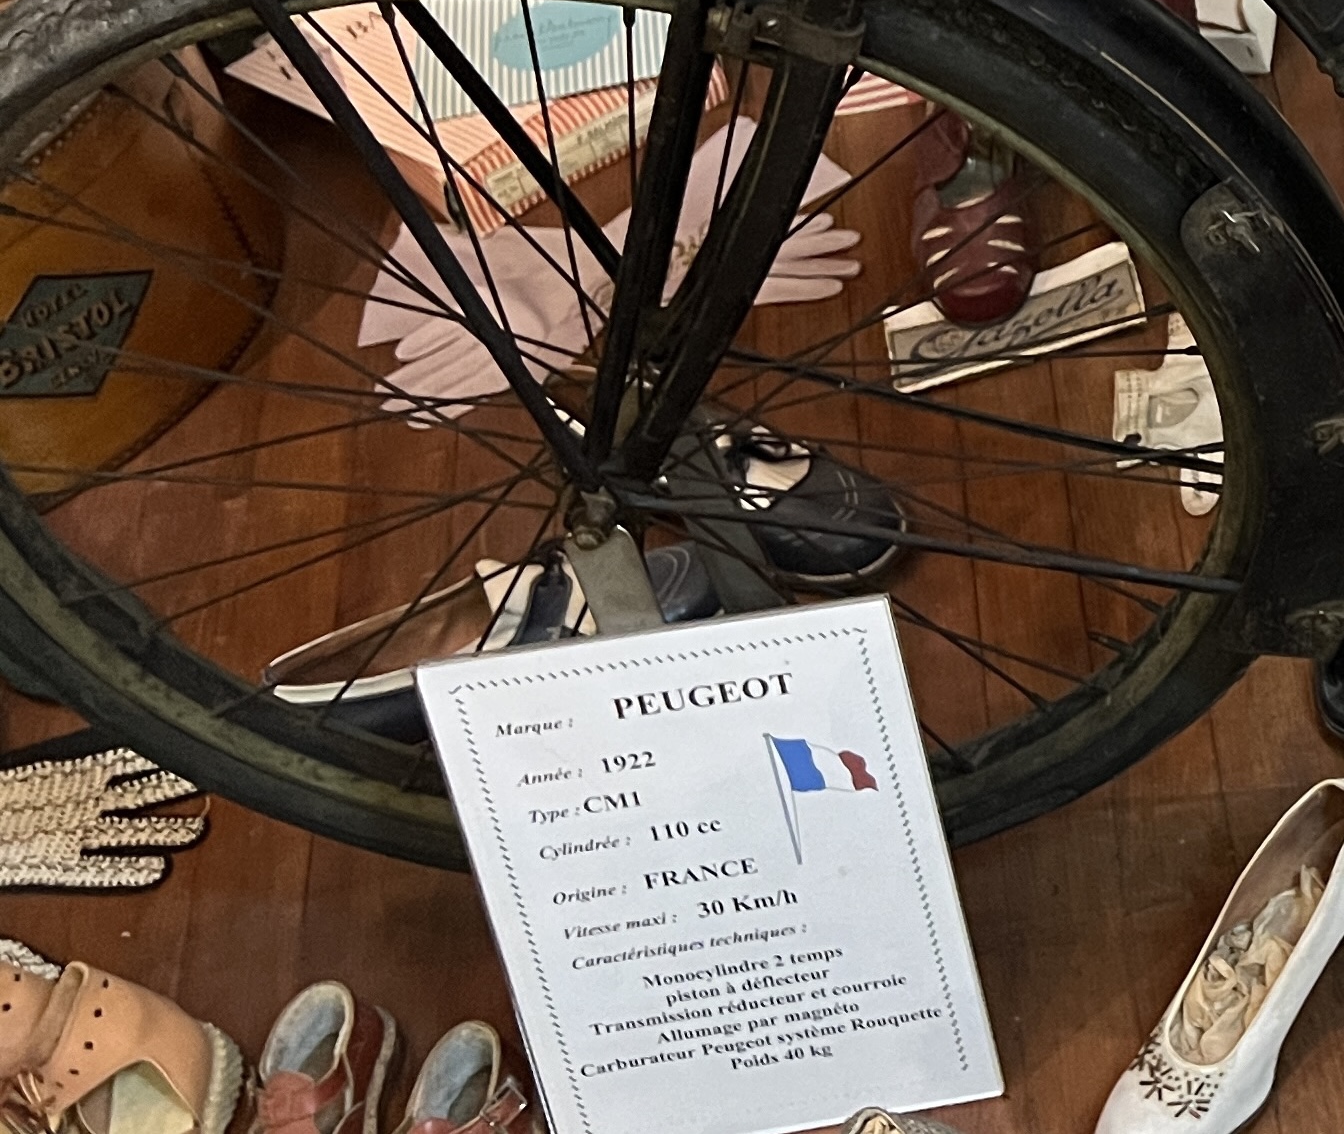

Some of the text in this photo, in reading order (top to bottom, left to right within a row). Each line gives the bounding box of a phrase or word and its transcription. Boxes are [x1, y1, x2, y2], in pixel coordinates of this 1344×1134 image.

[495, 719, 563, 738] Marque
[612, 672, 793, 720] PEUGEOT
[517, 768, 573, 787] Année
[601, 751, 657, 774] 1922
[528, 806, 569, 824] Type
[583, 791, 642, 814] CM1
[539, 836, 620, 861] Cylindrée
[650, 820, 690, 843] 110
[697, 819, 722, 834] cc
[553, 885, 617, 906] Origine
[643, 857, 759, 890] FRANCE
[563, 921, 621, 941] Vitesse
[626, 912, 667, 930] maxi
[697, 899, 725, 919] 30
[732, 888, 799, 914] Km/h
[572, 940, 705, 970] Caractéristiques
[710, 926, 796, 948] techniques
[642, 947, 844, 989] Monocylindre 2 temps
[588, 974, 907, 1036] Transmission réducteur et courroie
[666, 968, 830, 1007] piston à déflecteur
[580, 1007, 942, 1077] Carburateur Peugeot système Rouquette
[657, 1002, 860, 1045] Allumage par magnéto
[730, 1044, 834, 1071] Poids 40 kg
